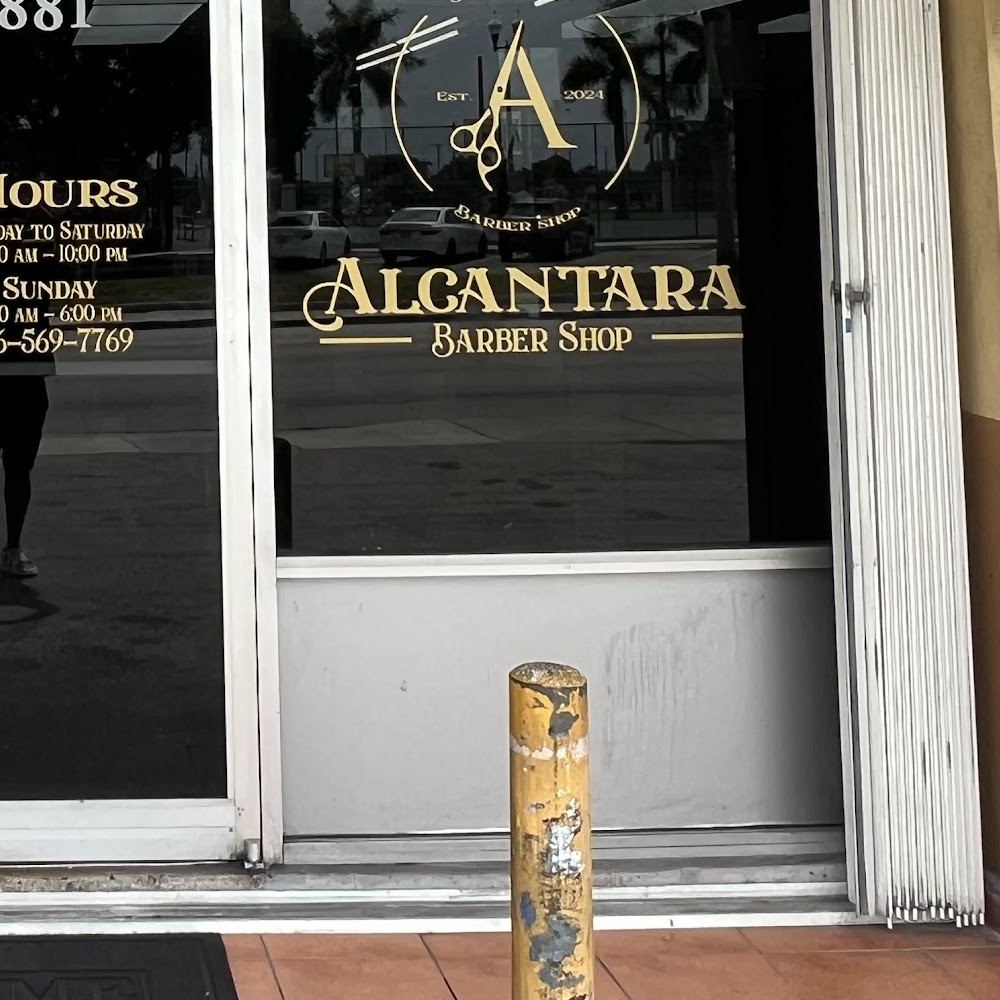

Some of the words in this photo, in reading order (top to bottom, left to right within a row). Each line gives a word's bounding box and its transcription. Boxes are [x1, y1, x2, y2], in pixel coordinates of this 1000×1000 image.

[563, 89, 604, 100] 2024
[453, 203, 533, 232] BARBER
[537, 205, 582, 230] SHOP
[30, 223, 54, 241] TO
[59, 220, 146, 241] SATURDAY
[13, 247, 38, 263] AM
[59, 243, 101, 264] 10:00
[105, 246, 128, 262] PM
[2, 276, 98, 300] SUNDAY
[302, 256, 747, 332] ALCANTARA
[14, 307, 39, 323] AM
[59, 303, 96, 323] 6:00
[100, 306, 123, 322] PM
[431, 322, 549, 358] BARBER
[558, 320, 633, 352] SHOP
